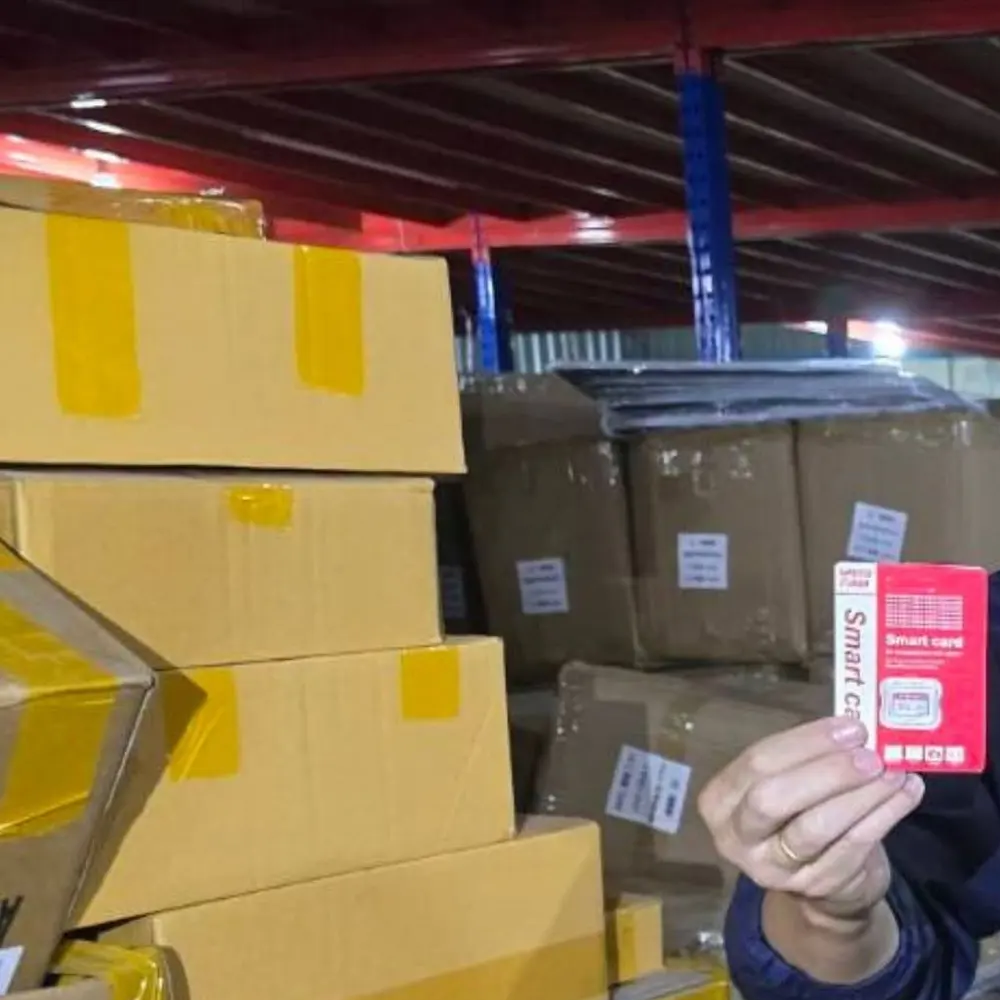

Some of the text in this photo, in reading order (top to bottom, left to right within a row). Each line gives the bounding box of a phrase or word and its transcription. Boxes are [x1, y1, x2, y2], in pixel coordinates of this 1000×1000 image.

[844, 608, 867, 687] Smart
[885, 633, 964, 649] Smart card
